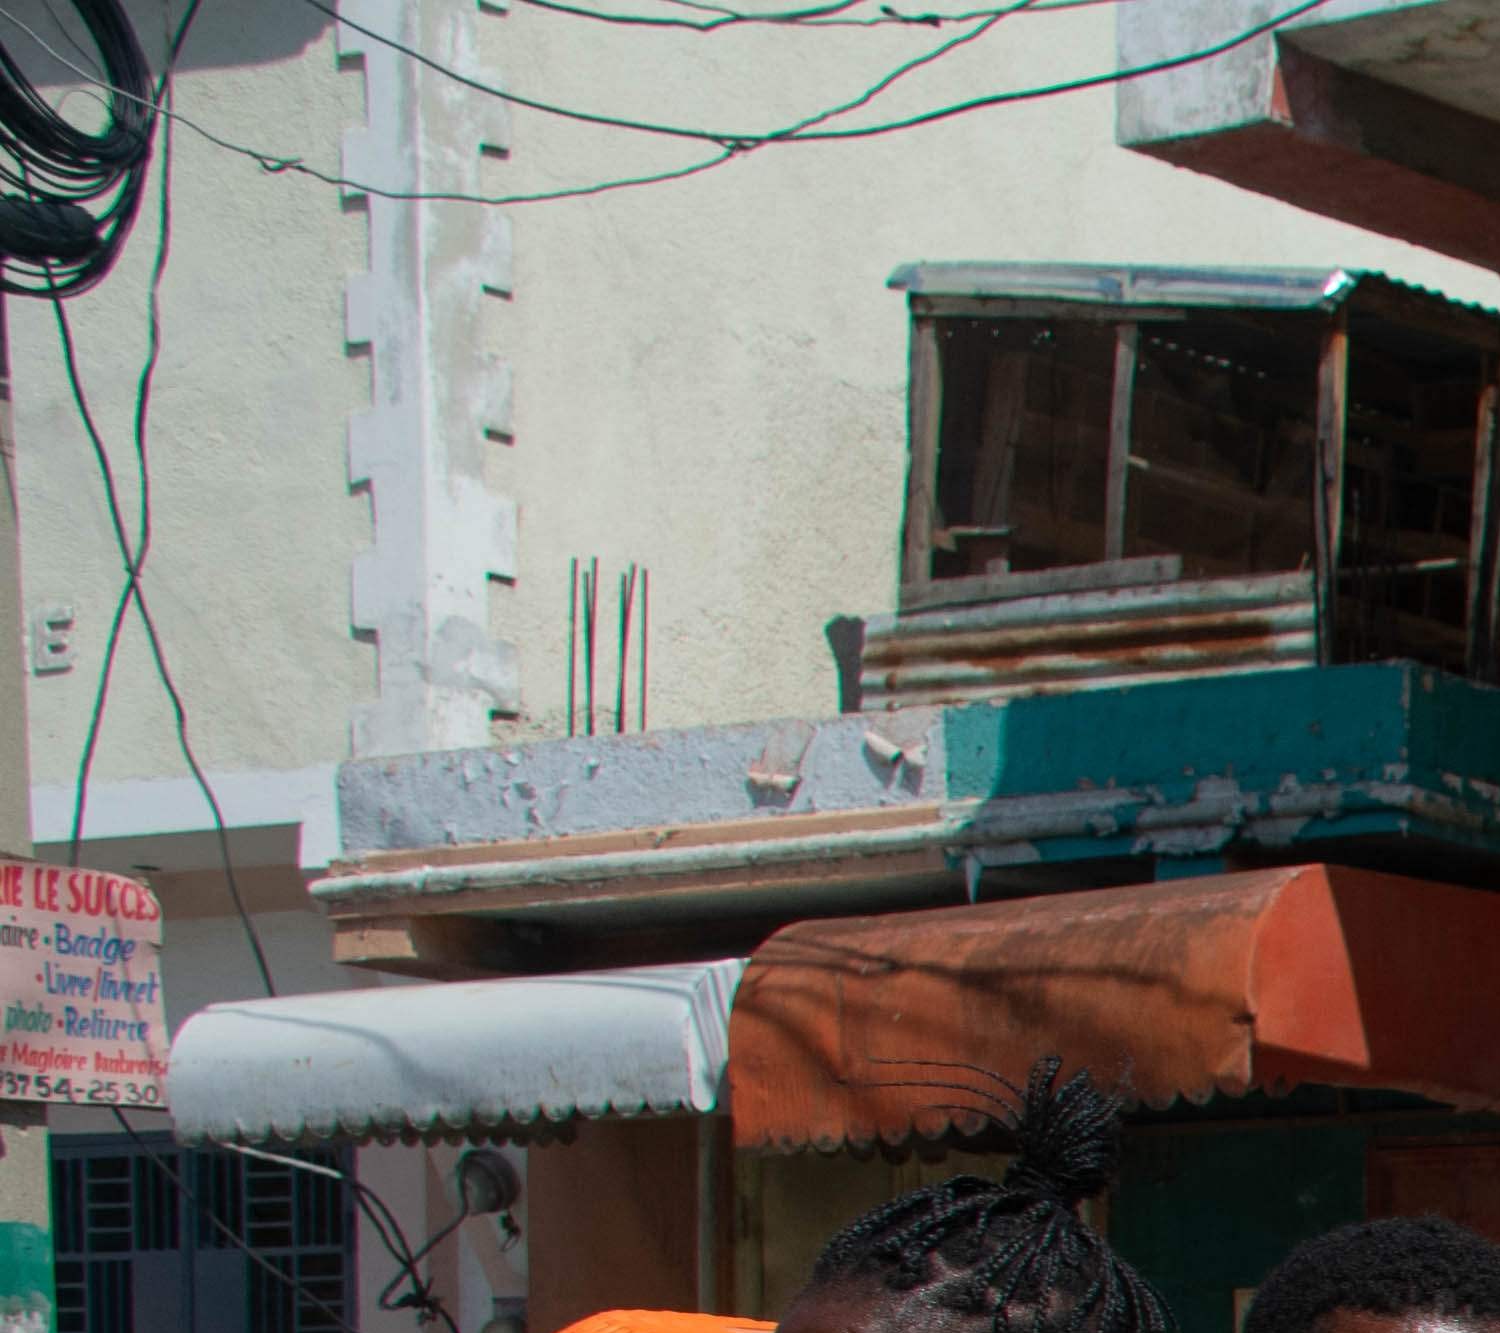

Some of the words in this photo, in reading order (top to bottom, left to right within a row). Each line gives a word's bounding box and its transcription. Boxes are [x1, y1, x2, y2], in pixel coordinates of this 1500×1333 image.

[0, 864, 23, 907] IE
[34, 868, 60, 913] LE
[54, 922, 137, 966] Badge
